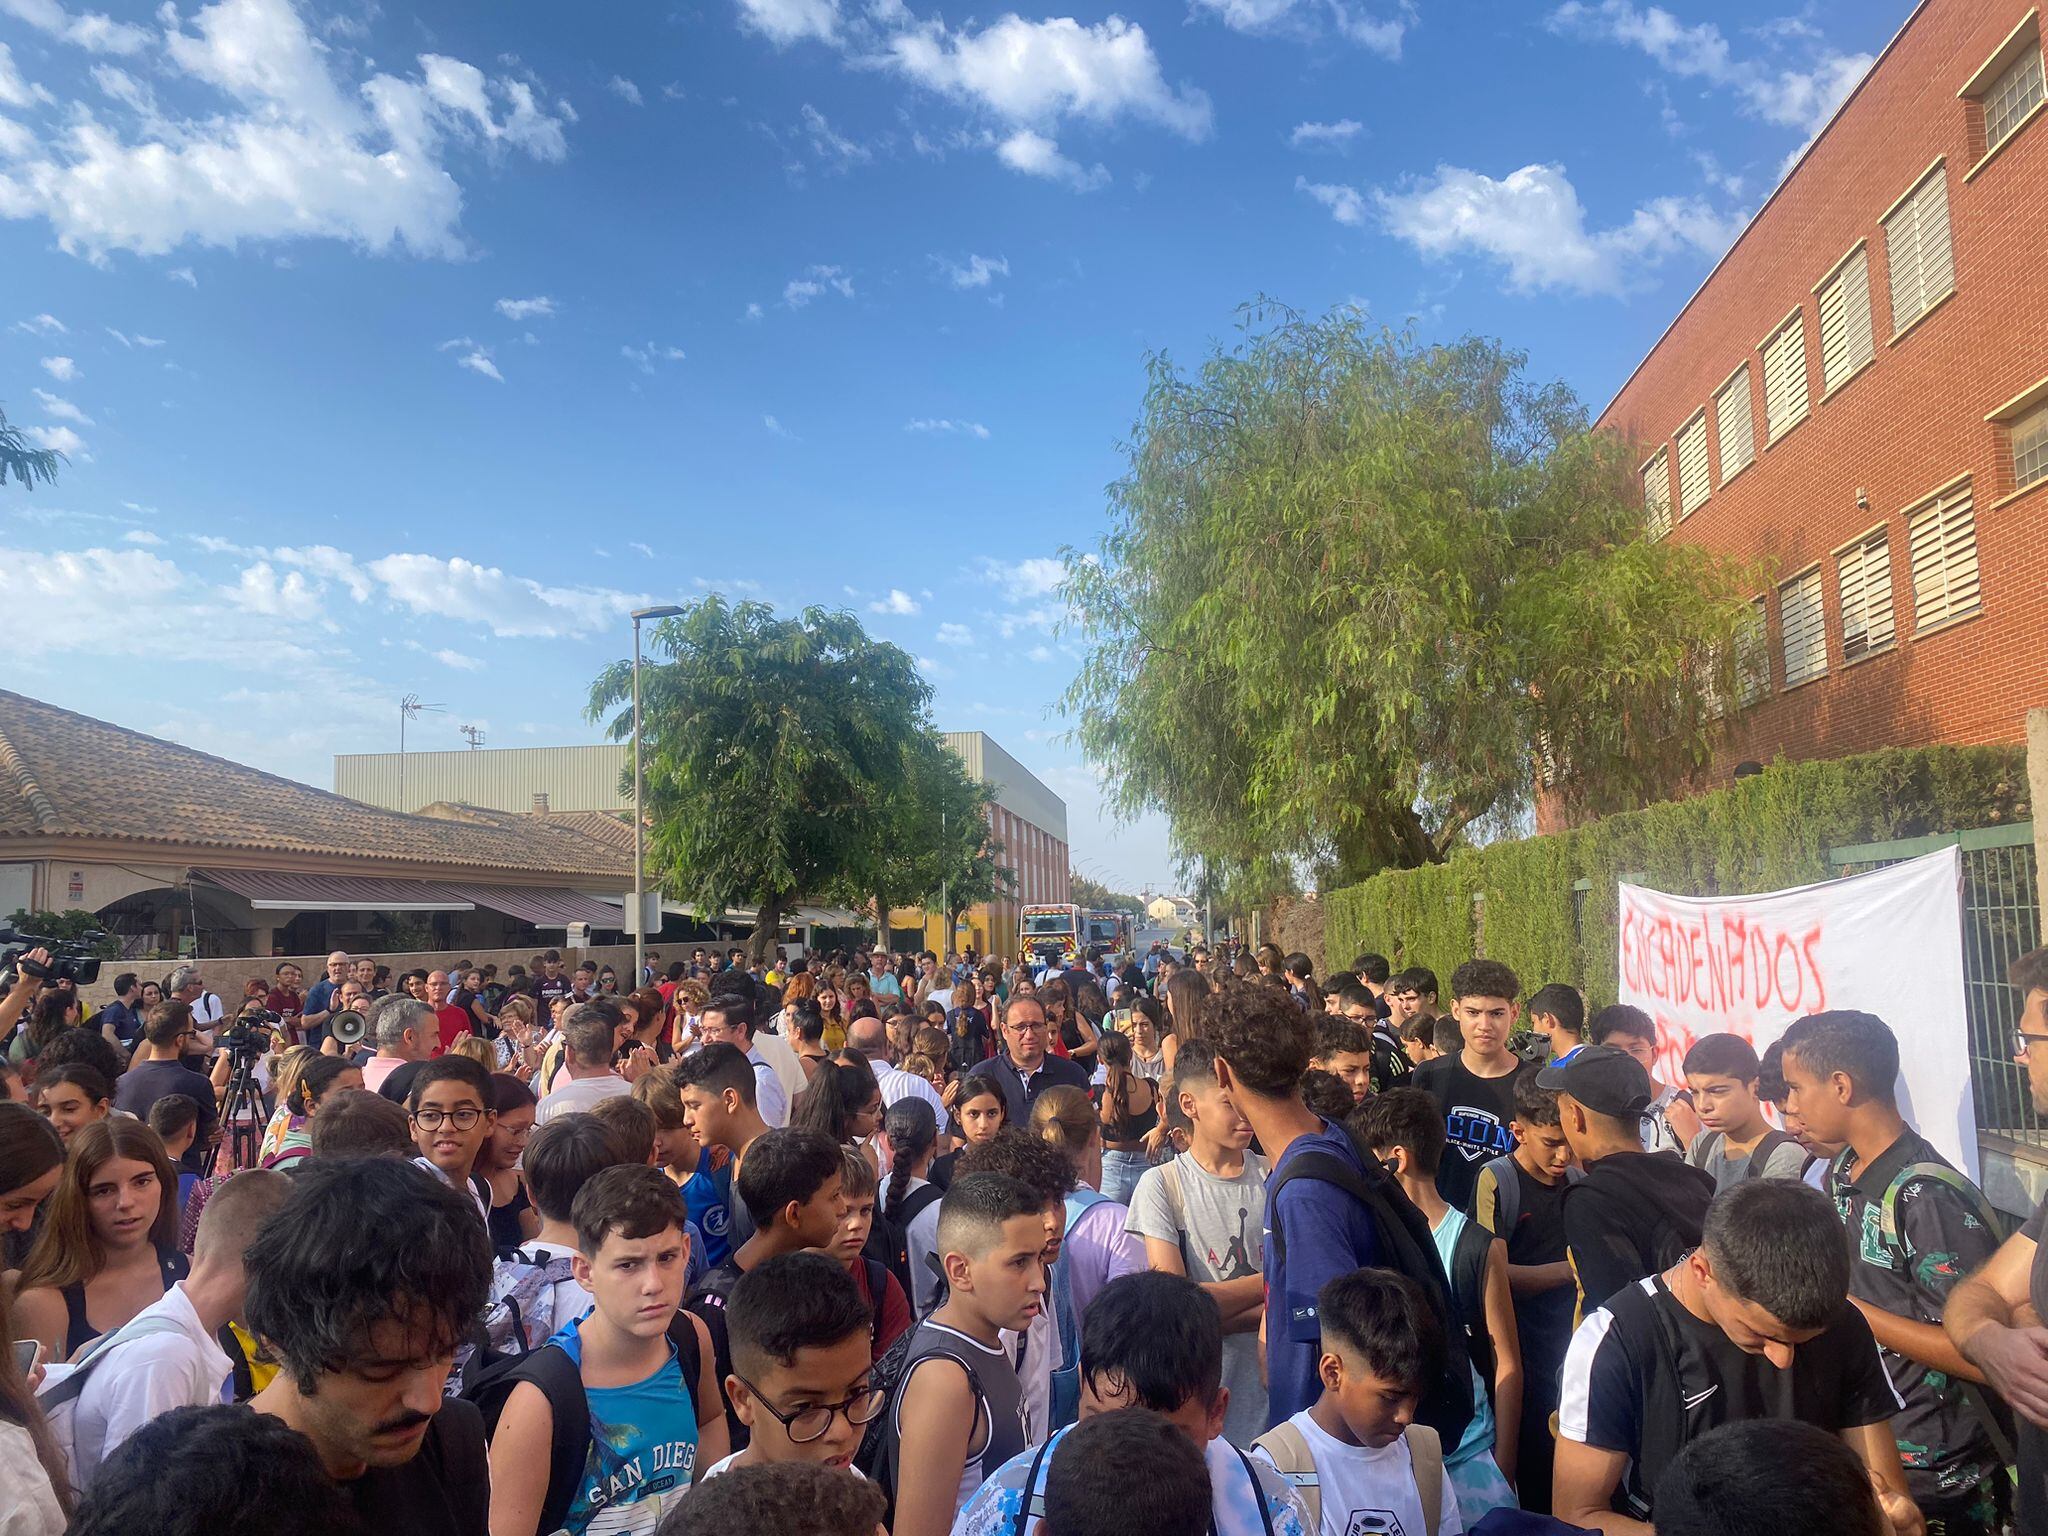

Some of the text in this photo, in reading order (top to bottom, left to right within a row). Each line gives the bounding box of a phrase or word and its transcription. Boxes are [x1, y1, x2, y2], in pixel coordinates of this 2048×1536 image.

[1622, 908, 1827, 1015] ENCADENADOS
[587, 1440, 696, 1509] SAN DIEG
